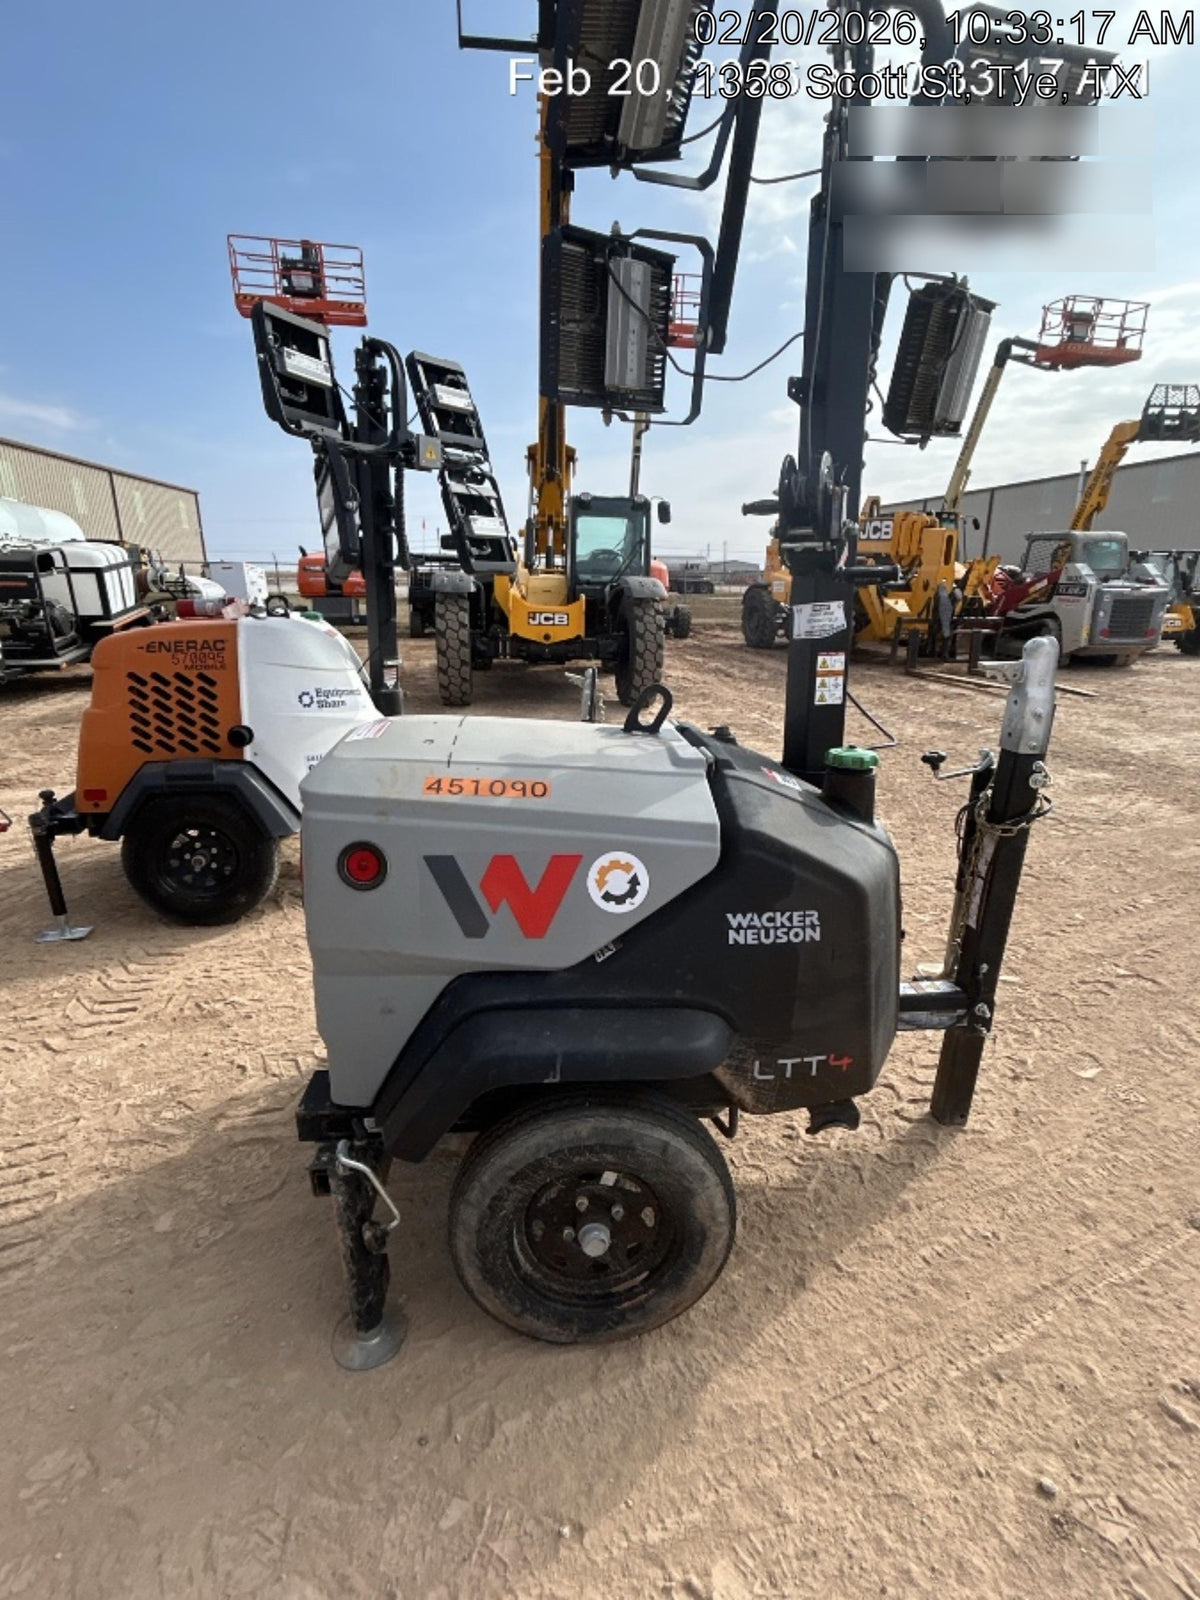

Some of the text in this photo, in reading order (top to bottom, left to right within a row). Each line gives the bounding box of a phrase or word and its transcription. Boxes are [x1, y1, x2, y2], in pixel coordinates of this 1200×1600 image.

[860, 520, 894, 540] JCB
[528, 612, 568, 625] JCB
[137, 640, 226, 653] ENERAC
[426, 778, 549, 798] 451090
[726, 910, 820, 929] WACKER
[728, 926, 821, 945] NEUSON
